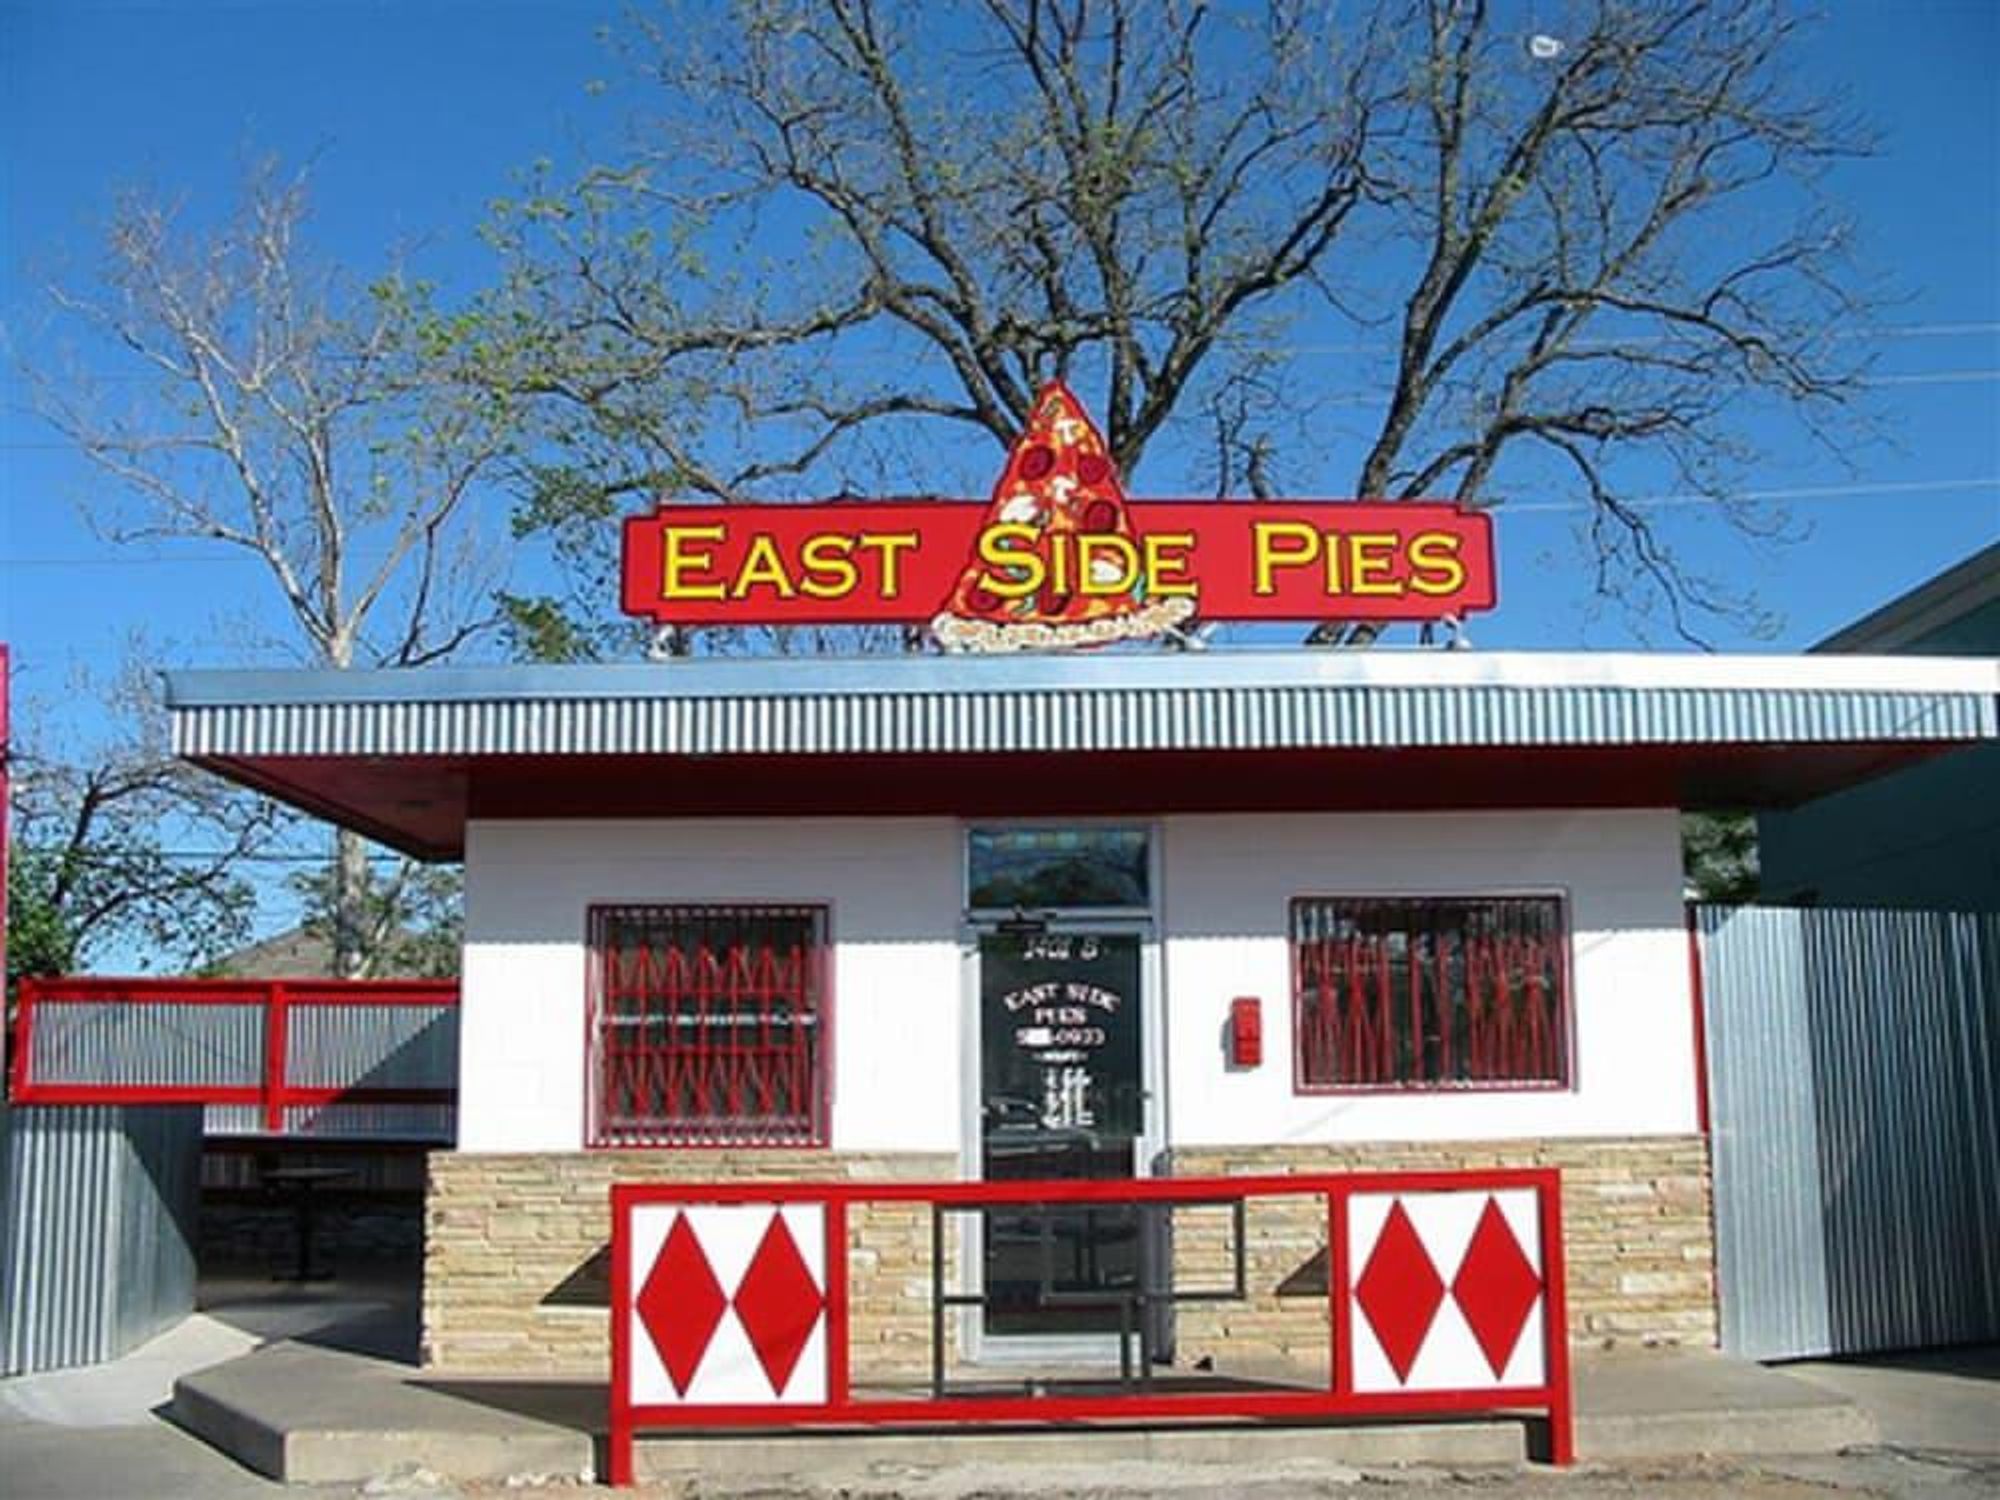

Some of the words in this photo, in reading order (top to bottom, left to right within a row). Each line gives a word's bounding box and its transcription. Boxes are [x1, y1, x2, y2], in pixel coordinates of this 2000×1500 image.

[662, 525, 919, 600] EAST
[977, 522, 1199, 597] SIDE
[1253, 521, 1465, 596] PIES
[1003, 982, 1059, 1012] EAST
[1066, 982, 1122, 1013] SIDE
